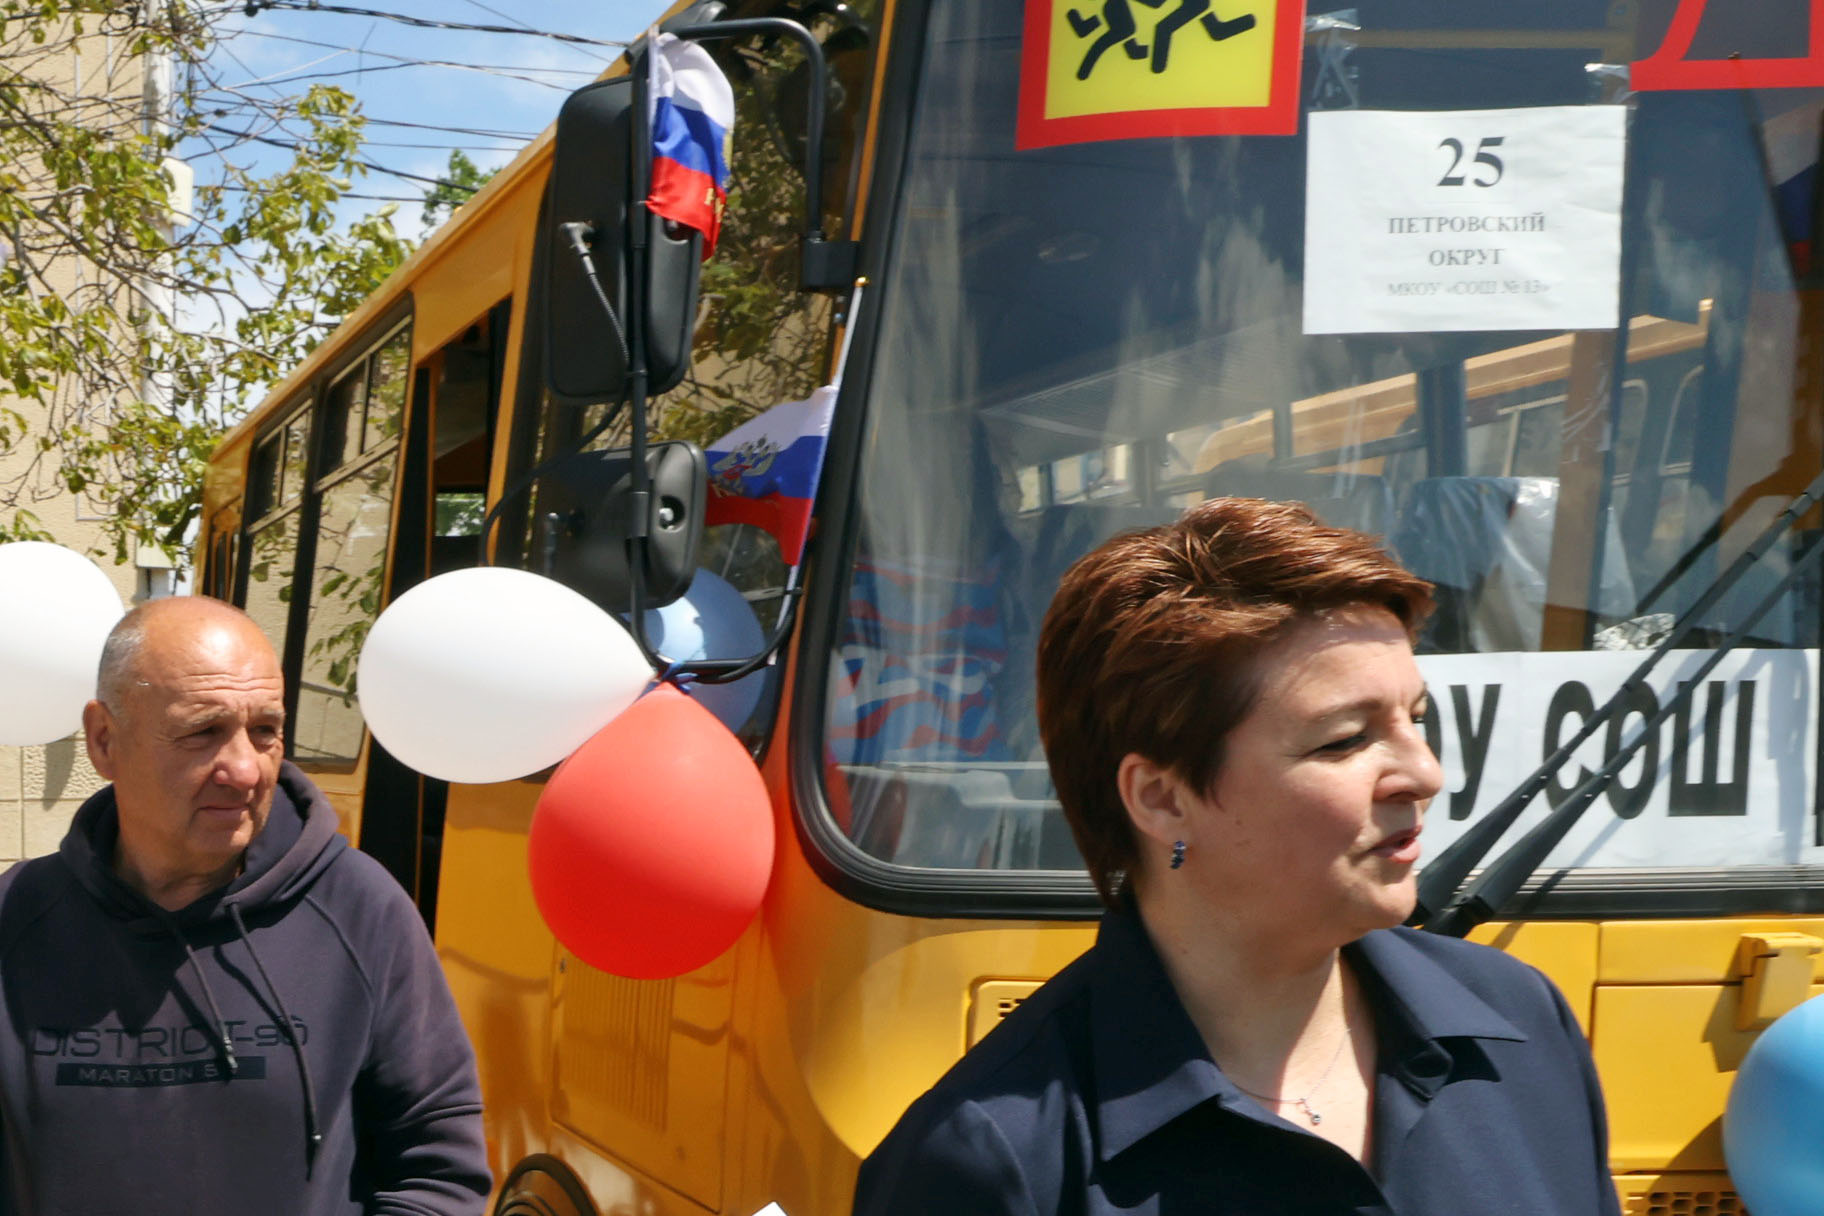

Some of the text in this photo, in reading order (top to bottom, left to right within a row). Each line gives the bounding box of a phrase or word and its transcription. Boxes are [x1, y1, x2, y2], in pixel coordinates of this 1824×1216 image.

[1436, 136, 1506, 188] 25
[1387, 211, 1546, 234] ПЕТРОВСКИЙ
[1428, 248, 1506, 266] ОКРУГ
[1542, 680, 1757, 820] СОШ
[78, 1067, 194, 1084] MARATON
